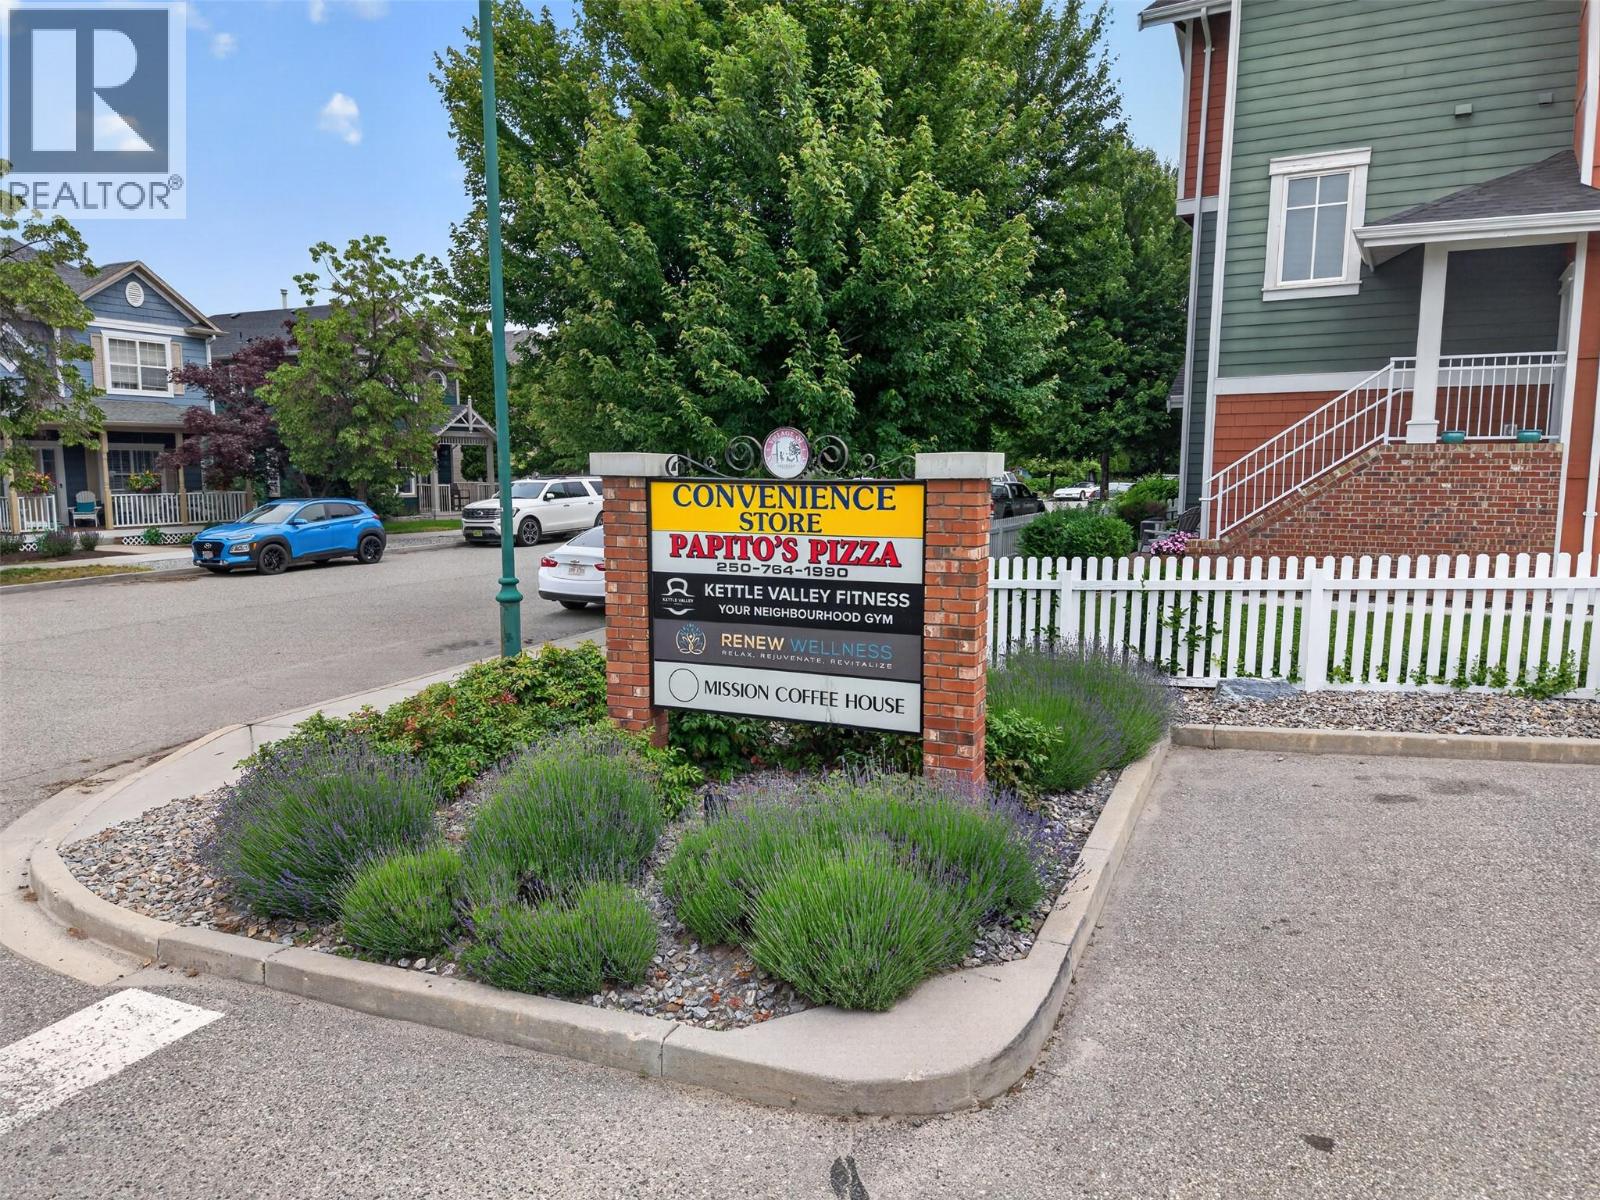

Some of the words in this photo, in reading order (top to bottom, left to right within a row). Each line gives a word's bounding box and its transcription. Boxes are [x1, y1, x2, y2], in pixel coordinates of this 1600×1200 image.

[672, 484, 896, 511] CONVENIENCE
[739, 512, 823, 533] STORE
[669, 534, 799, 563] PAPITO'S
[808, 539, 902, 568] PIZZA
[717, 562, 849, 578] 250-764-1990
[704, 583, 763, 600] KETTLE
[768, 587, 831, 604] VALLEY
[836, 590, 910, 608] FITNESS
[719, 604, 751, 616] YOUR
[754, 606, 861, 623] NEIGHBOURHOOD
[864, 613, 893, 625] GYM
[721, 633, 785, 651] RENEW
[790, 638, 893, 660] WELLNESS
[721, 650, 756, 659] RELAX,
[760, 653, 825, 664] REJUVENATE,
[830, 659, 893, 670] REVITALIZE
[704, 680, 769, 701] MISSION
[775, 686, 838, 708] COFFEE
[845, 693, 905, 715] HOUSE
